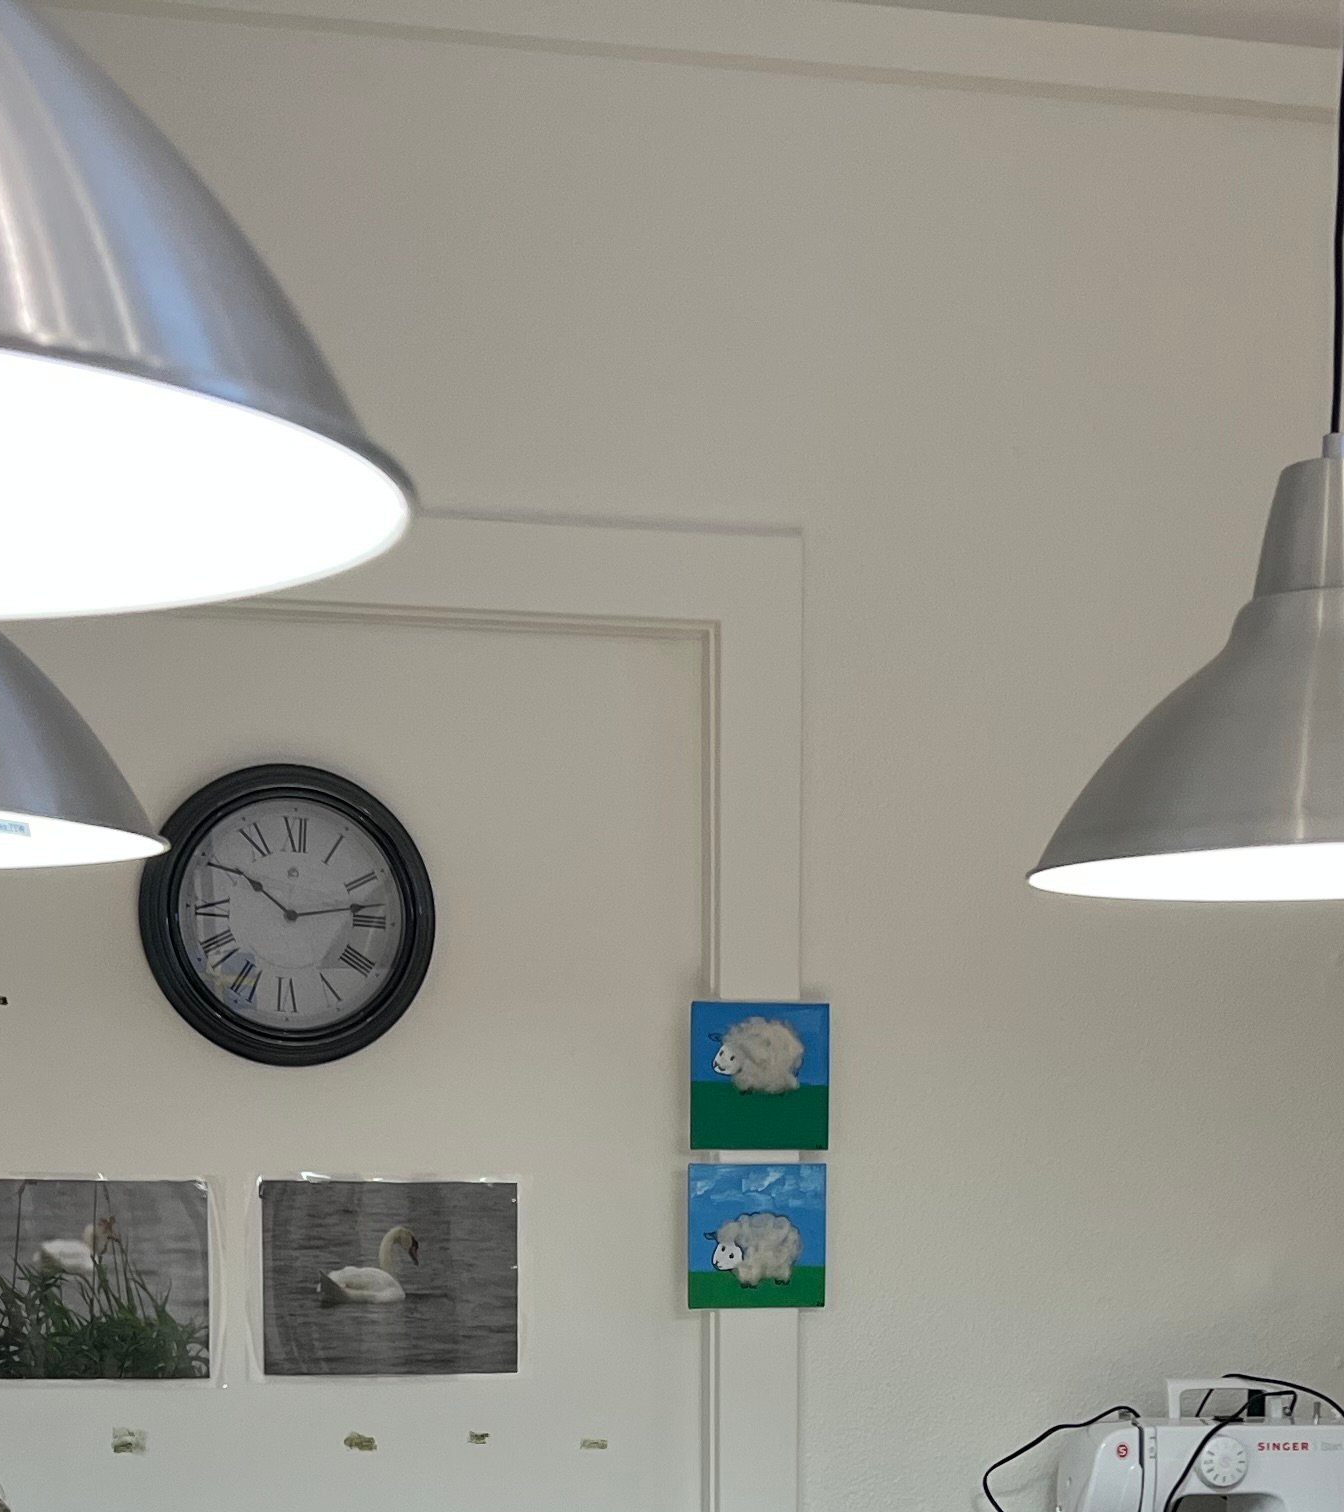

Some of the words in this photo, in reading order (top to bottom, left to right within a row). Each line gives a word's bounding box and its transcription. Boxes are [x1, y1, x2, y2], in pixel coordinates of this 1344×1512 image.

[240, 822, 273, 862] XI
[281, 816, 308, 854] XII
[322, 834, 345, 864] I
[343, 871, 378, 893] II
[195, 897, 231, 919] IX
[352, 913, 387, 930] III
[199, 931, 240, 969] VIII
[230, 960, 263, 1002] VII
[277, 976, 298, 1013] VI
[320, 973, 342, 1008] V
[1257, 1442, 1309, 1451] SINGER
